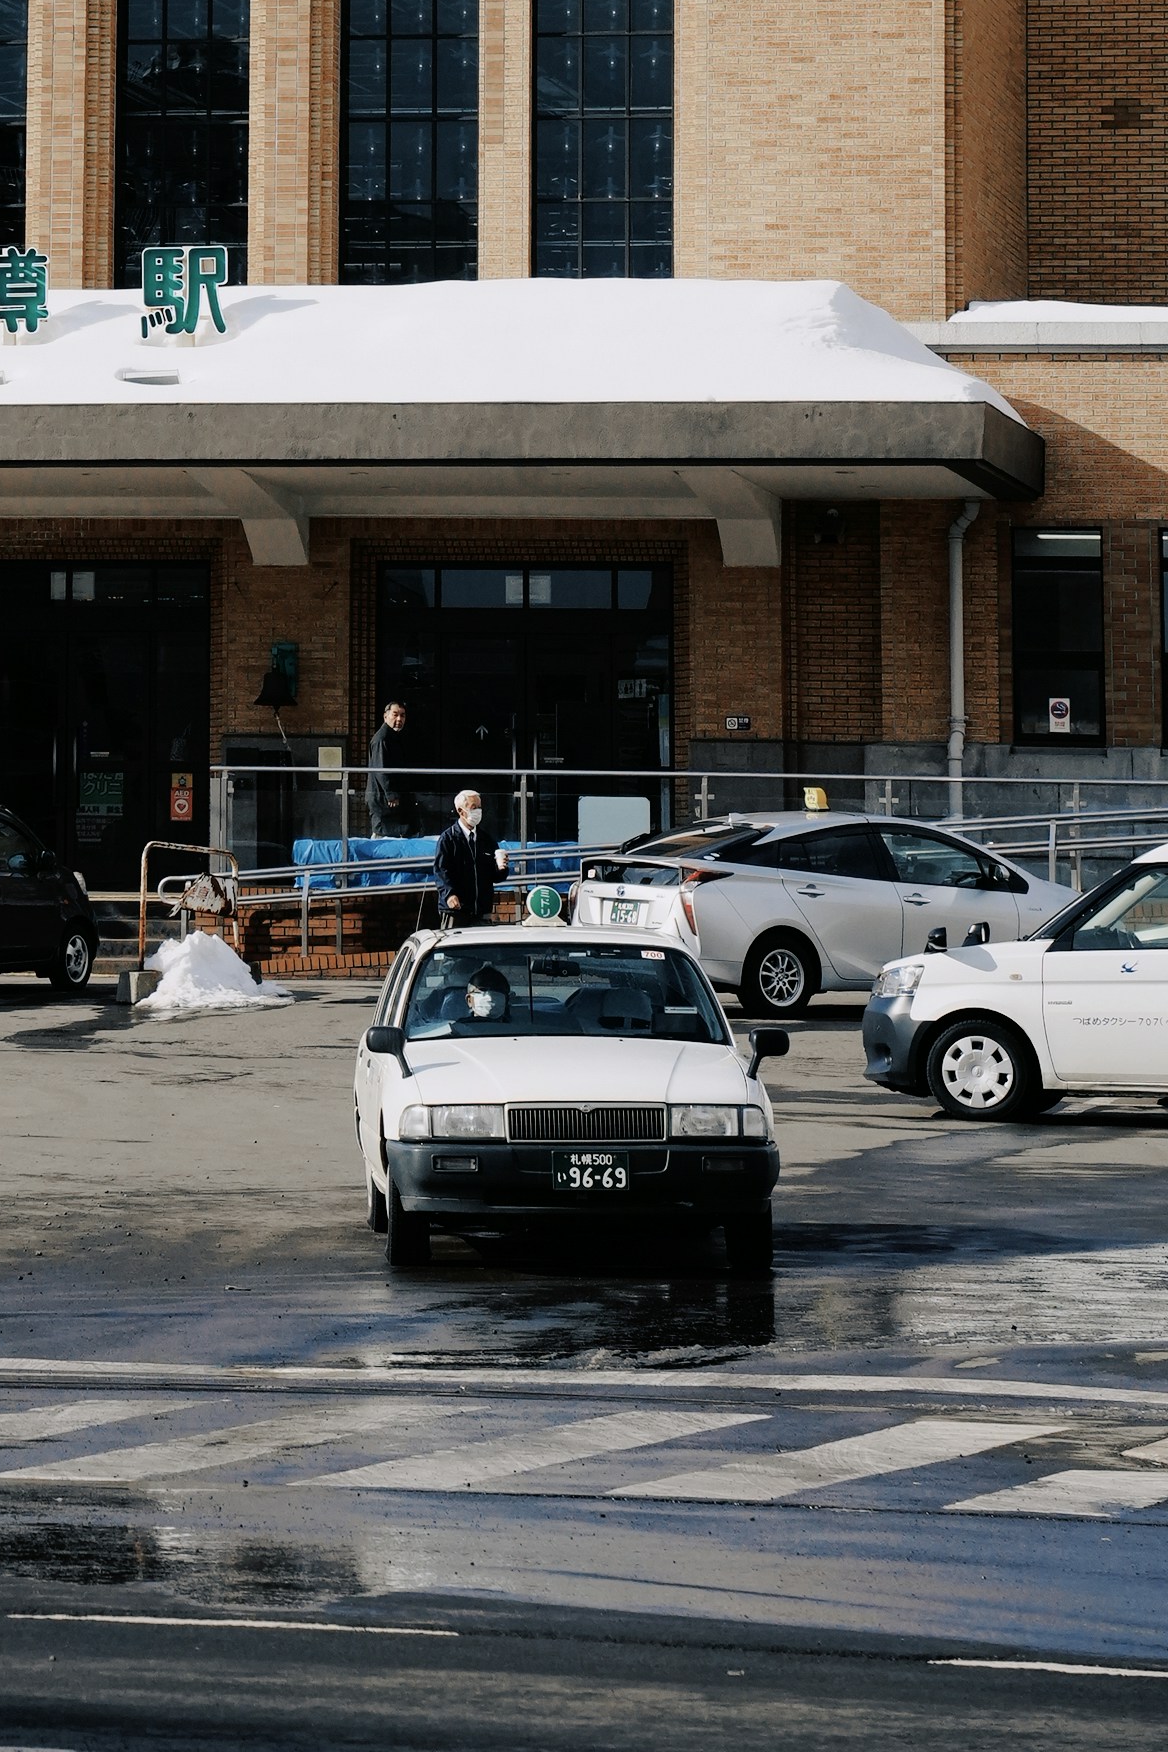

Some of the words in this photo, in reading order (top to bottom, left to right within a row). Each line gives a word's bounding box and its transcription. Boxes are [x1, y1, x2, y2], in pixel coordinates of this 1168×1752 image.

[540, 889, 550, 917] ミドリ
[643, 951, 664, 959] 700
[569, 1153, 613, 1166] 札幌500
[557, 1171, 567, 1183] い
[569, 1166, 627, 1189] 96-69
